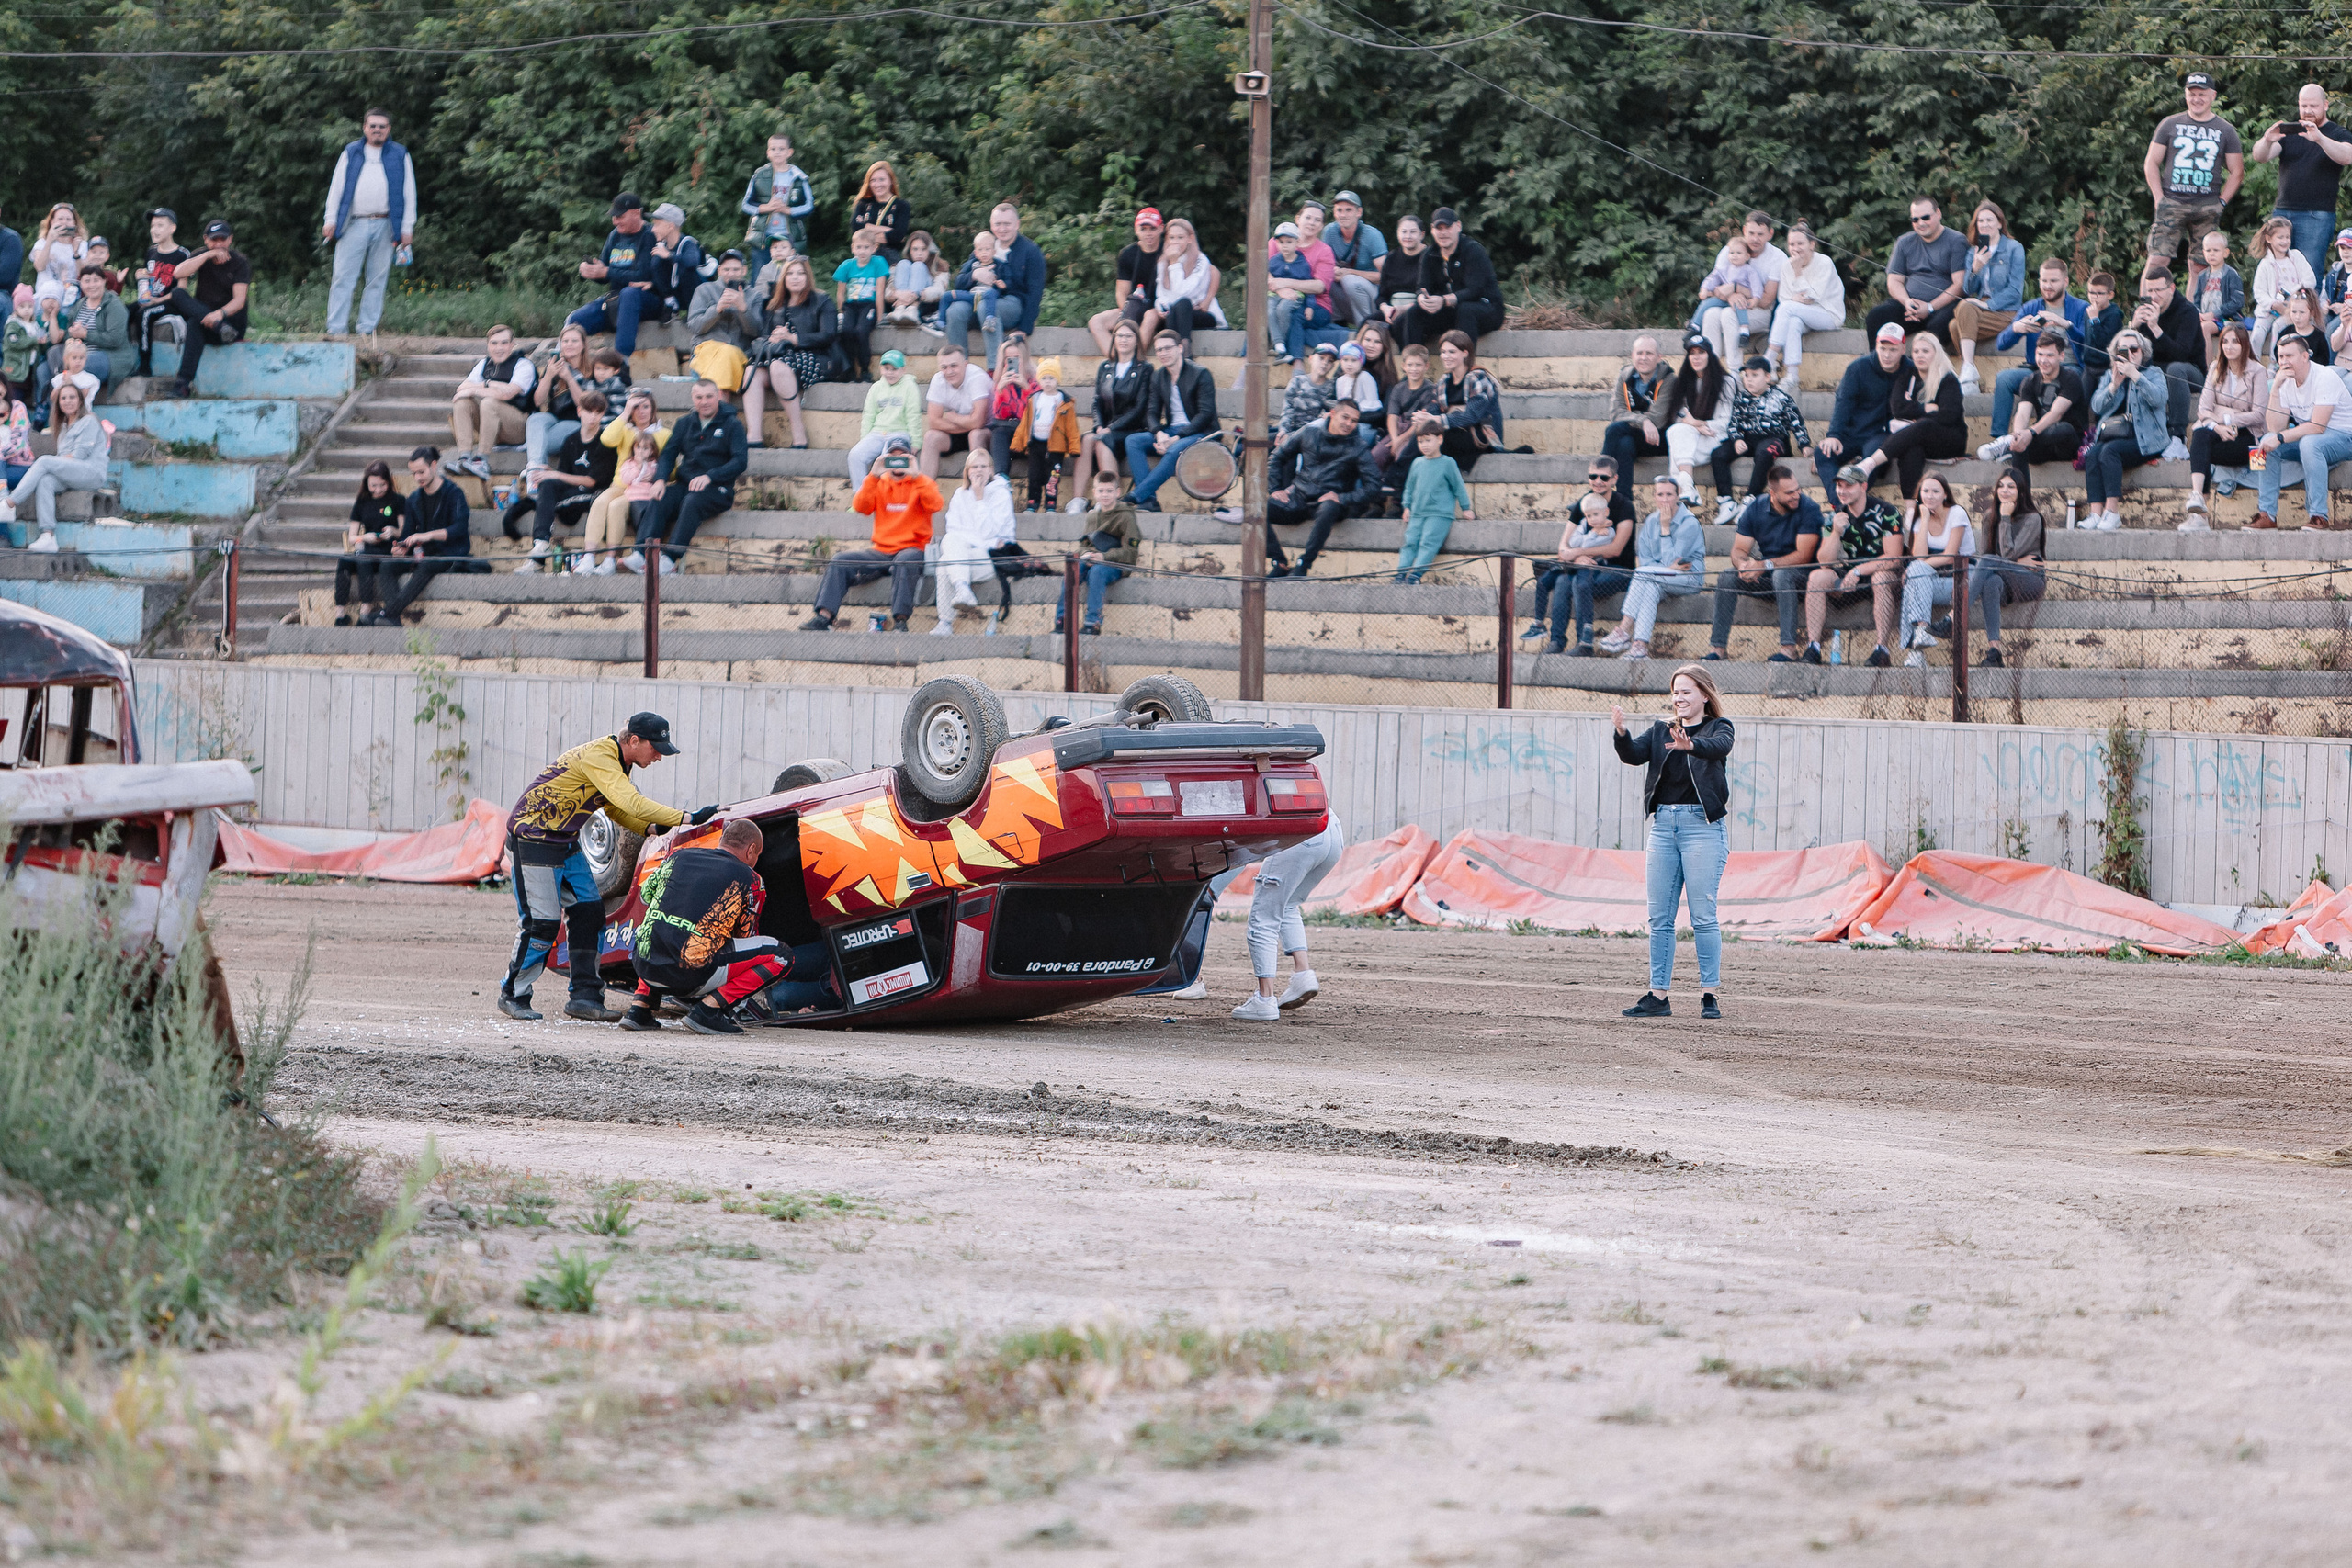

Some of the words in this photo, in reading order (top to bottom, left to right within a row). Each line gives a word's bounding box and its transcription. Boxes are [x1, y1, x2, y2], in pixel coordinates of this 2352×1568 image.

[2176, 124, 2222, 142] TEAM
[2173, 136, 2219, 172] 23
[2172, 168, 2213, 186] STOP
[1026, 962, 1080, 972] 39-00-01
[1082, 958, 1144, 973] Pandora
